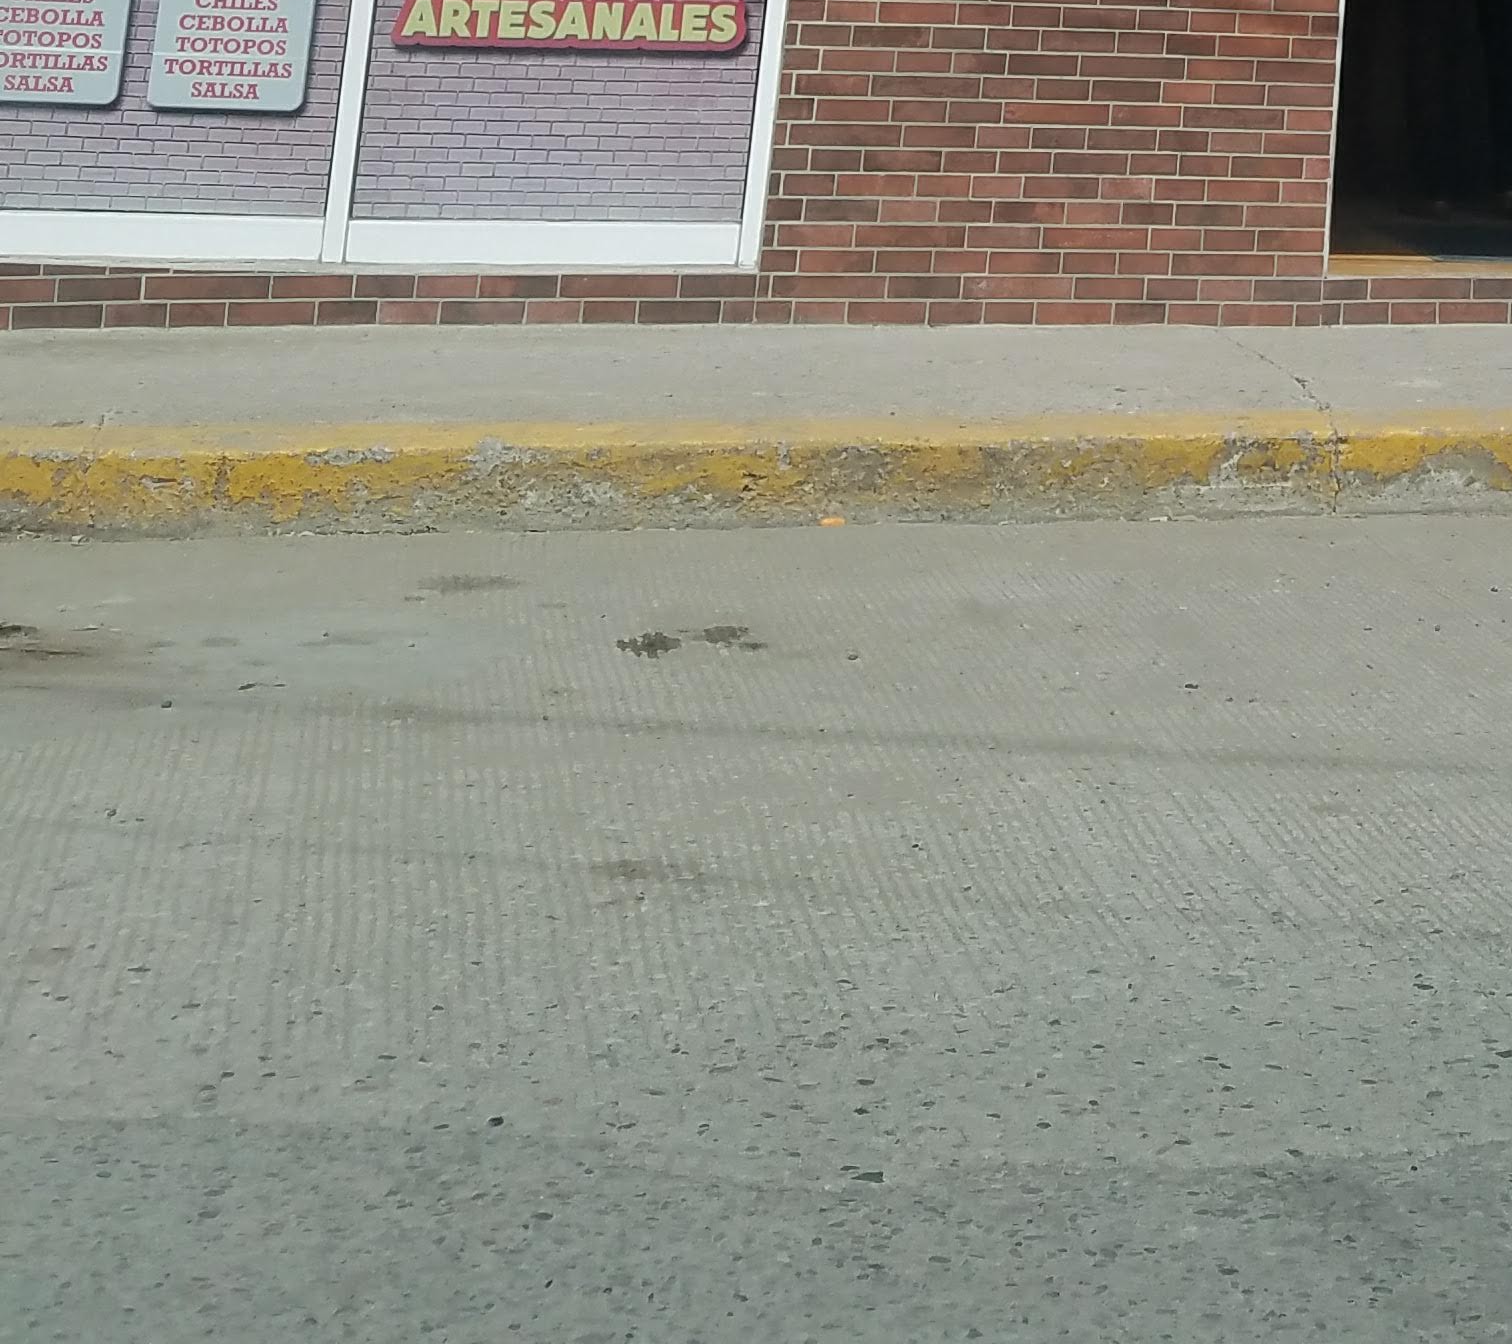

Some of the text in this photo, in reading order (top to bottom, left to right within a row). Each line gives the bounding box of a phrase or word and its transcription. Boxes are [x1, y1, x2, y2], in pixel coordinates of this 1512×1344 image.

[0, 6, 105, 27] CEBOLLA
[179, 14, 288, 33] CEBOLLA
[0, 30, 103, 49] OTOPOS
[175, 36, 287, 56] TOTOPOS
[0, 52, 108, 72] ORTILLAS
[164, 58, 293, 79] TORTILLAS
[4, 74, 74, 93] SALSA
[190, 81, 260, 100] SALSA
